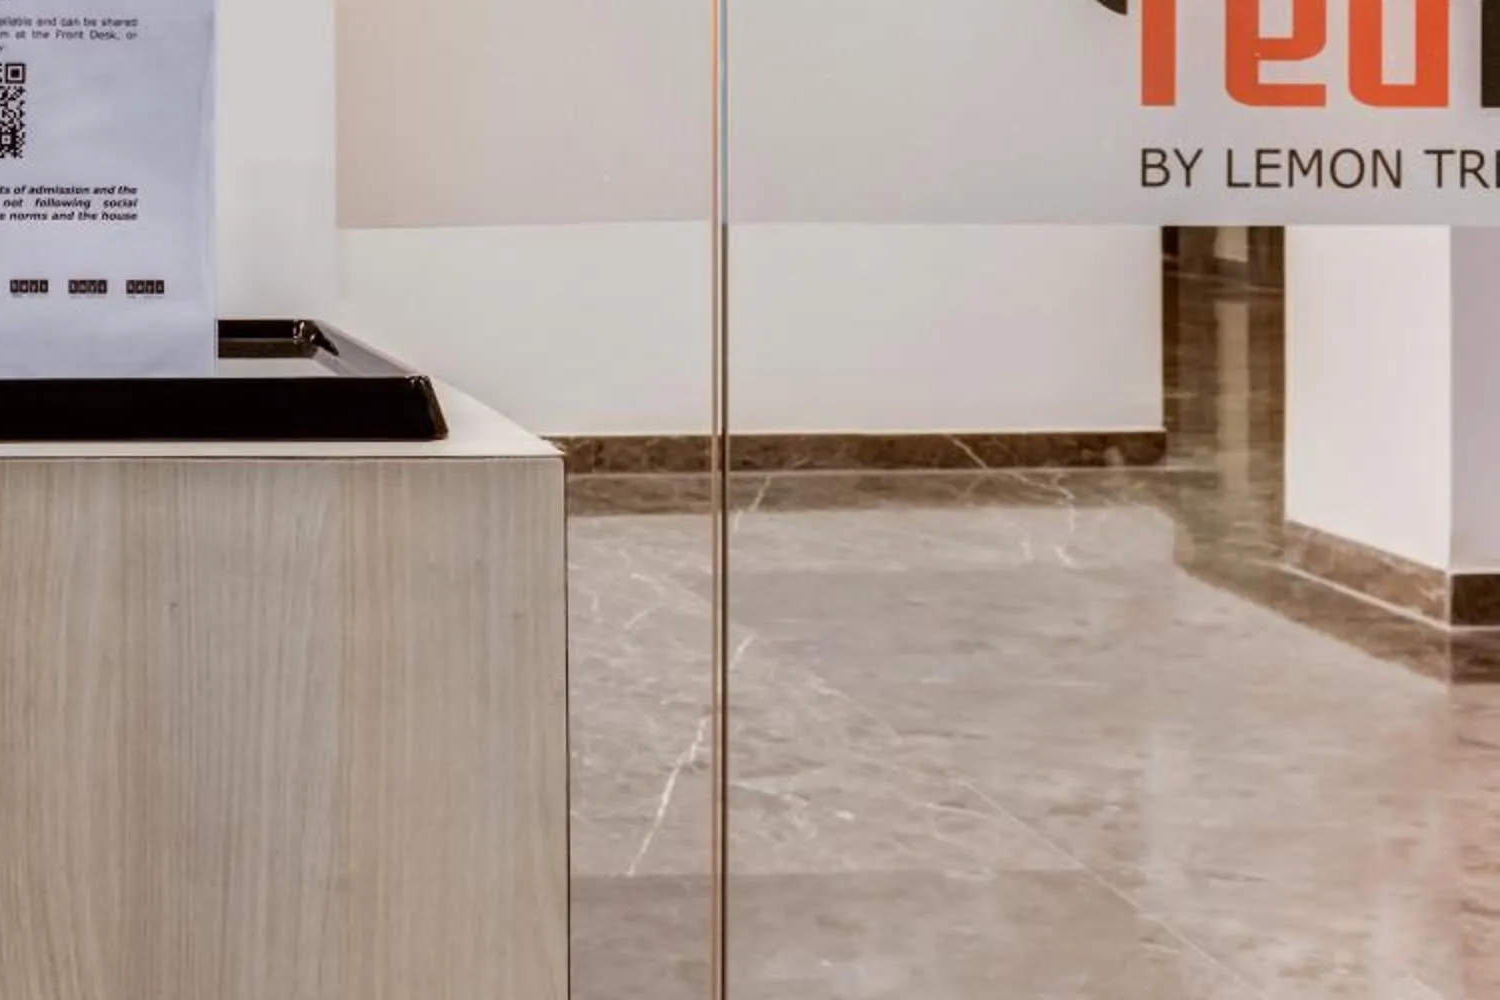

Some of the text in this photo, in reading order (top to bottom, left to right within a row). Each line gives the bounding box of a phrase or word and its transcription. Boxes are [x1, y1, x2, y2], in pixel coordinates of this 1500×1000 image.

[35, 15, 57, 26] and
[82, 15, 98, 27] be
[14, 28, 26, 40] at
[30, 28, 50, 40] the
[54, 29, 84, 40] Front
[1141, 148, 1500, 188] BY LEMON TR
[12, 184, 26, 195] of
[26, 184, 91, 195] admission
[91, 184, 116, 195] and
[116, 184, 138, 195] the
[2, 197, 23, 208] not
[33, 197, 91, 210] following
[101, 197, 138, 208] social
[8, 212, 48, 221] norms
[50, 210, 74, 221] and
[76, 210, 98, 221] the
[99, 210, 138, 221] house
